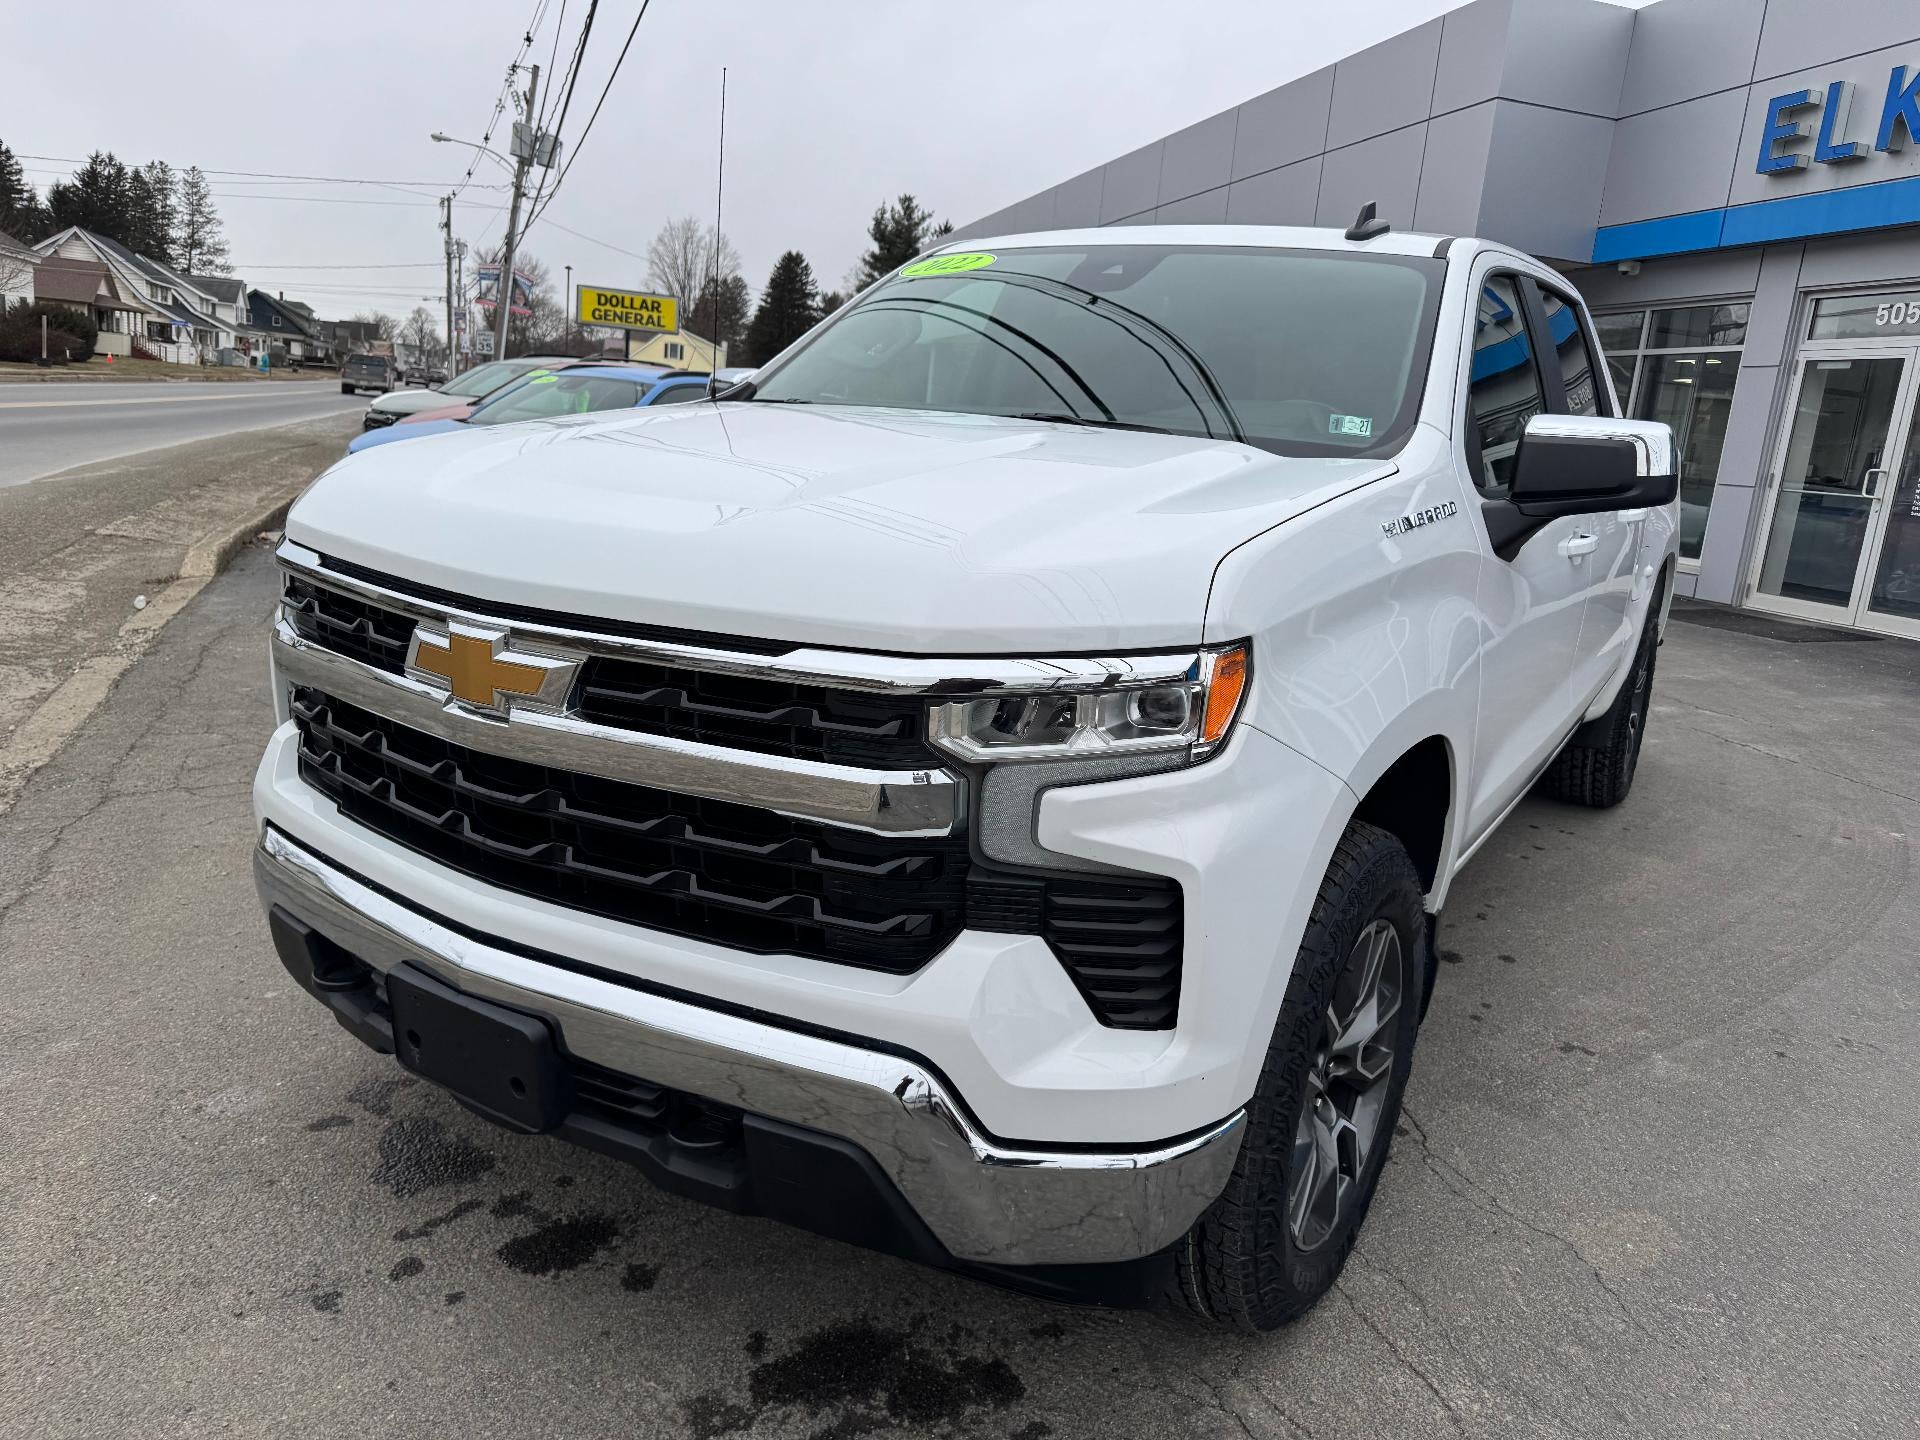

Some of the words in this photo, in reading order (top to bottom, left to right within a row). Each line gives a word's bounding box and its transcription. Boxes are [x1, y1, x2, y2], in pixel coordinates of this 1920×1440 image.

[597, 293, 662, 313] DOLLAR
[591, 308, 666, 328] GENERAL
[1875, 301, 1920, 326] 505
[479, 342, 493, 352] 35
[1359, 419, 1370, 434] 27
[1381, 501, 1458, 538] SILVERADO
